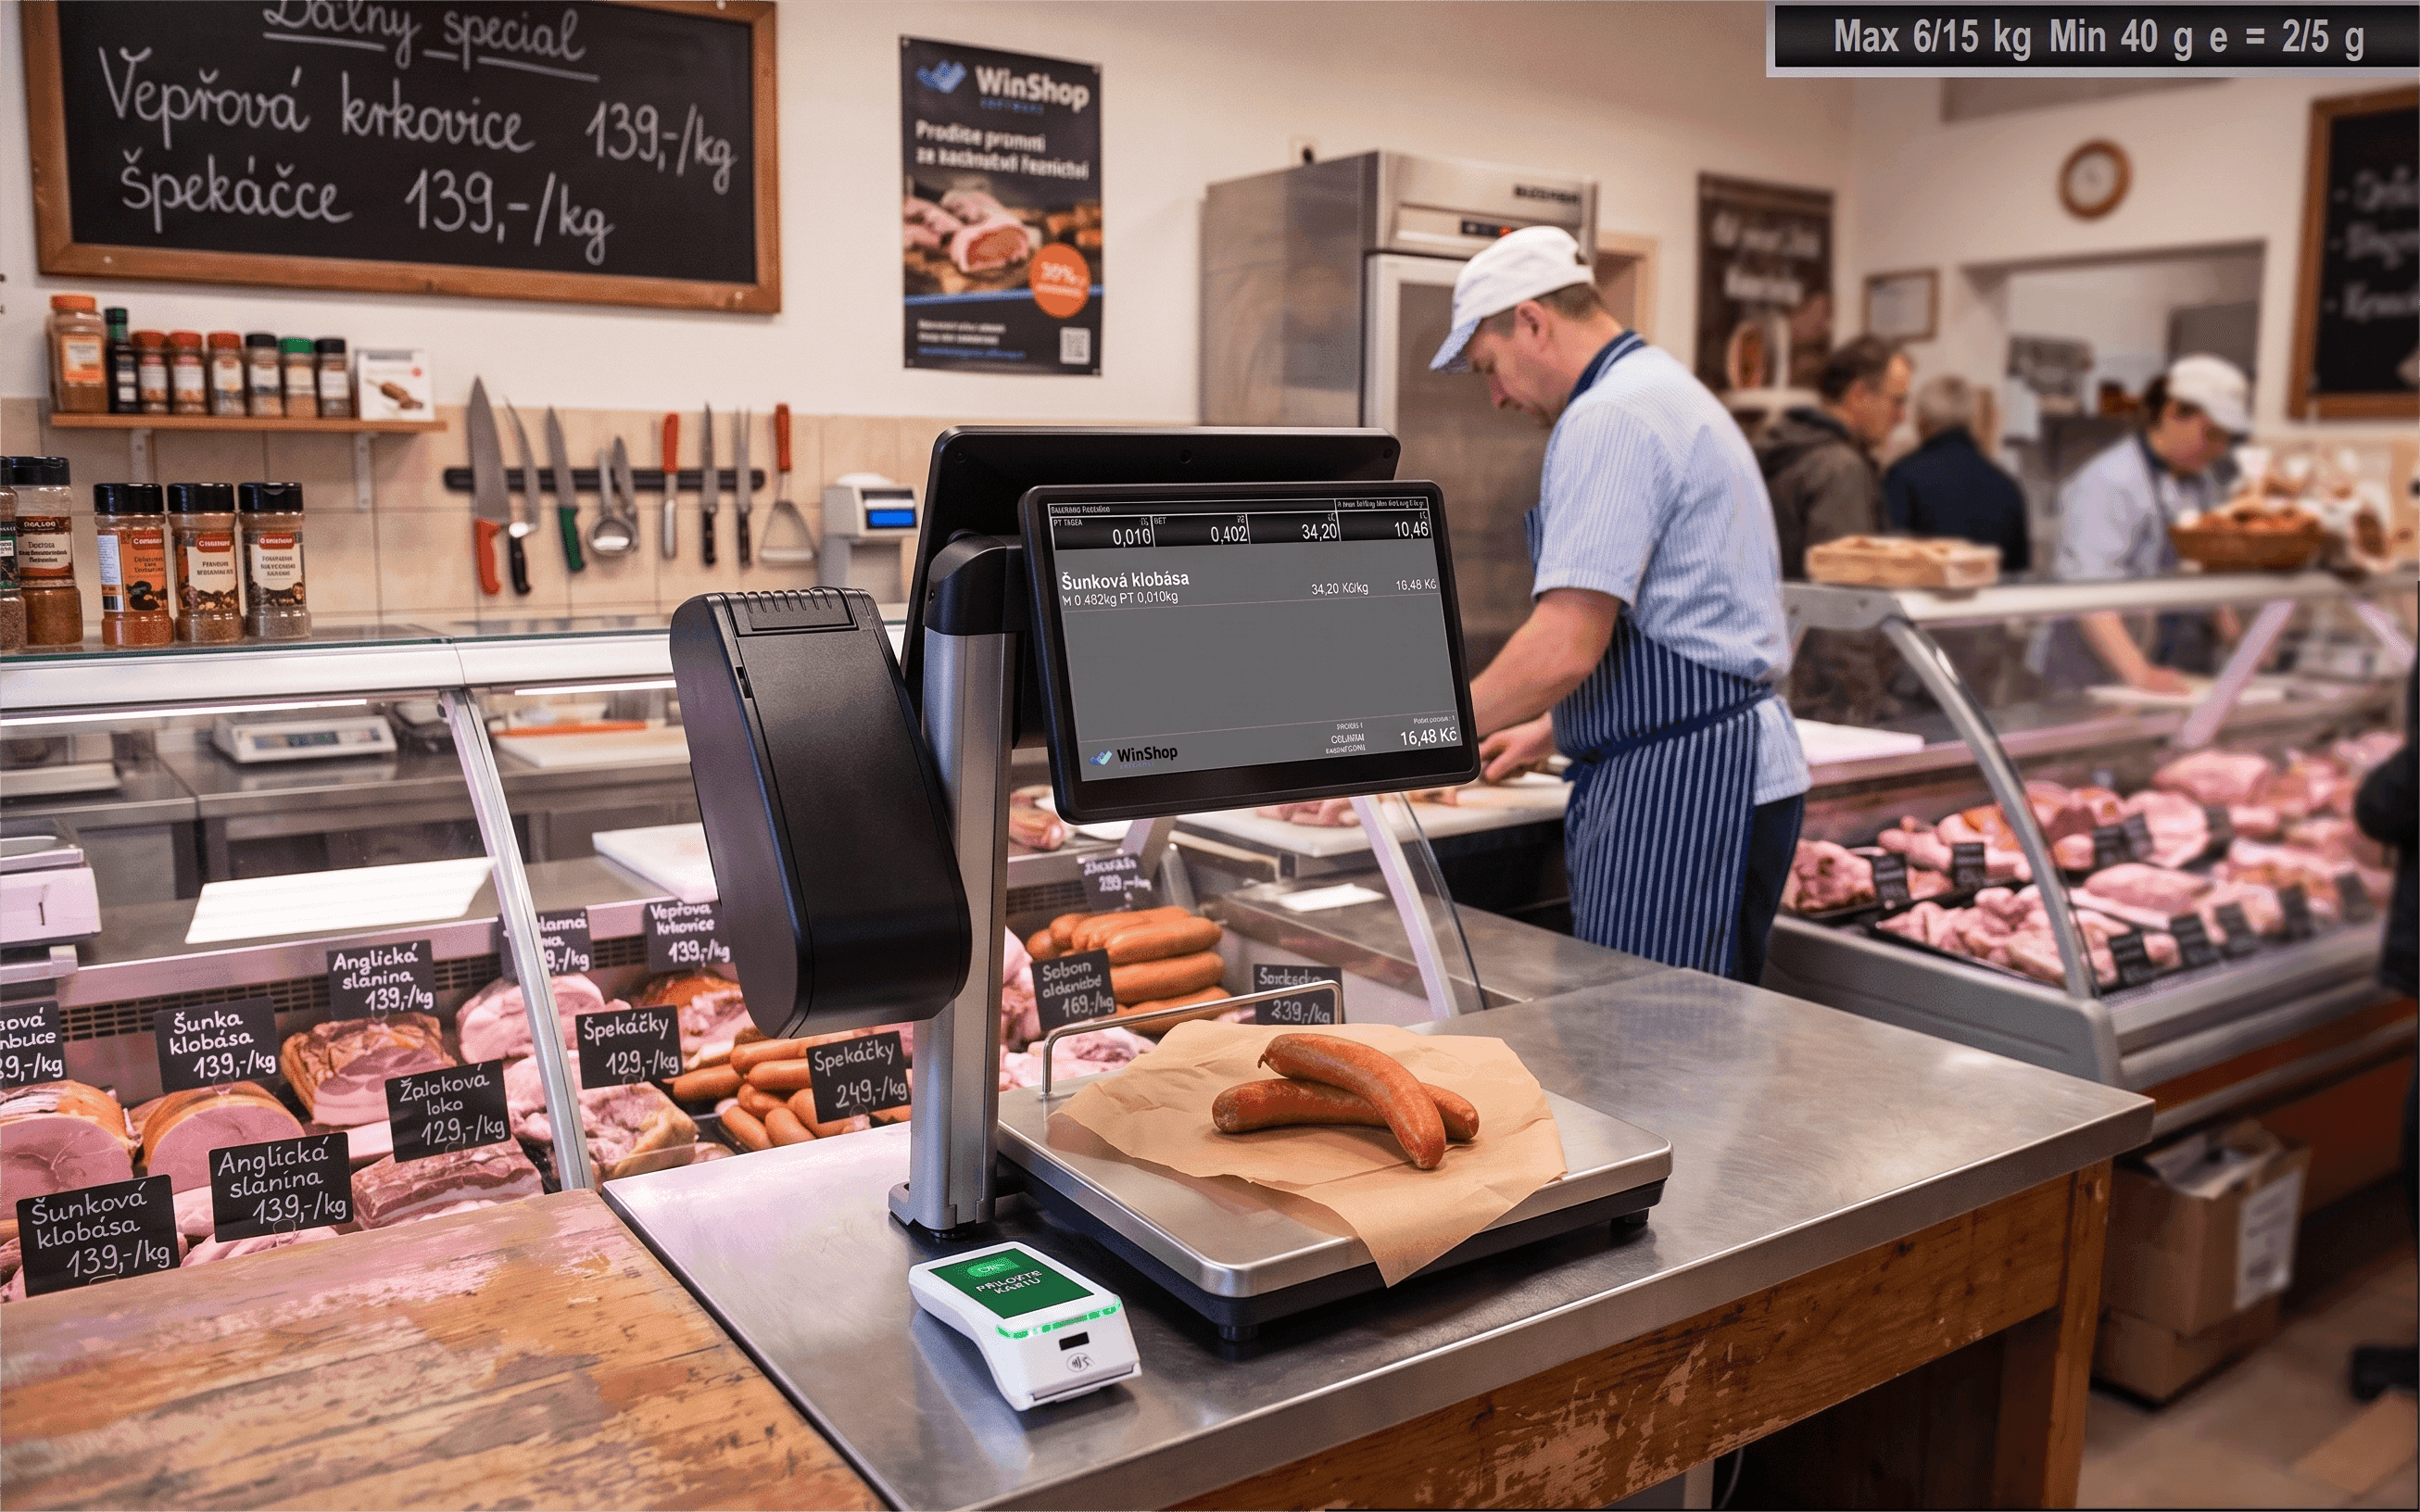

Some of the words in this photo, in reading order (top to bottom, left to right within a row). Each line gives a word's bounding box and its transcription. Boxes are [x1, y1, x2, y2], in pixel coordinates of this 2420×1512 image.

[443, 8, 587, 71] special
[976, 64, 1090, 114] WinShop
[98, 45, 310, 150] Vepřová
[342, 70, 536, 153] krkovice
[586, 101, 738, 195] 139,-/kg
[404, 168, 615, 265] 139,-/kg
[1210, 525, 1248, 545] 0,402
[1302, 523, 1337, 541] 34,20
[1394, 521, 1429, 539] 10,46
[1062, 571, 1128, 590] Šunková
[1131, 570, 1190, 587] klobása
[1311, 583, 1339, 596] 34,20
[1119, 592, 1134, 604] PT
[1137, 590, 1178, 604] 0,010kg
[1400, 728, 1437, 747] 16,48
[1440, 726, 1457, 742] Kč
[1116, 746, 1178, 762] WinShop
[333, 942, 419, 976] Anglická
[342, 970, 414, 990] slanina
[364, 984, 434, 1011] 139,-/kg
[173, 1011, 244, 1035] Šunka
[584, 1012, 669, 1047] Špekáčky
[169, 1029, 255, 1055] klobása
[193, 1049, 277, 1079] 139,-/kg
[605, 1049, 680, 1082] 129,-/kg
[836, 1076, 908, 1109] 249,-/kg
[421, 1114, 506, 1146] 129,-/kg
[31, 1180, 148, 1226] Šunková
[252, 1191, 347, 1225] 139,-/kg
[36, 1216, 142, 1250] klobása
[66, 1239, 170, 1279] 139,-/kg
